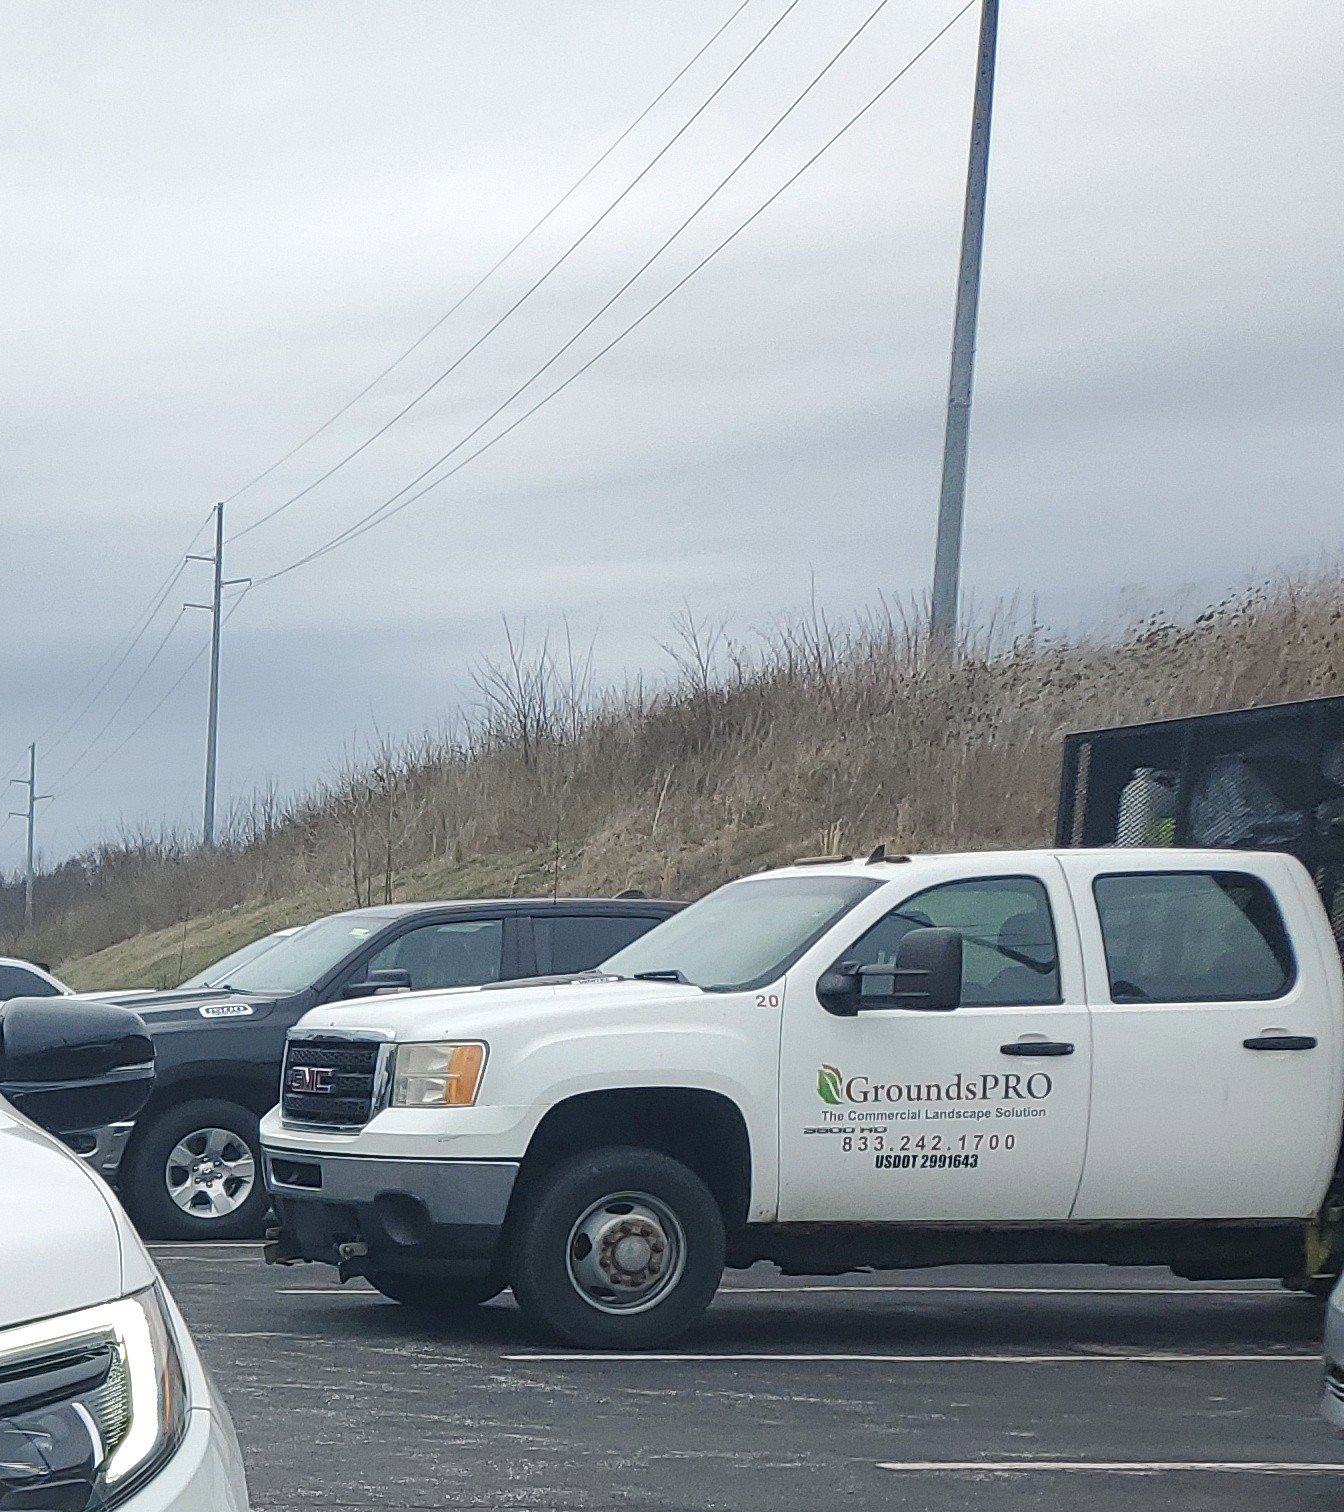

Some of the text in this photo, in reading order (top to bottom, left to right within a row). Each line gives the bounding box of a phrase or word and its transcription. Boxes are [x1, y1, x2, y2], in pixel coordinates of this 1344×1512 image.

[755, 994, 779, 1008] 20
[288, 1066, 333, 1093] GMC
[845, 1073, 1053, 1104] GroundsPRO
[822, 1107, 1046, 1122] The Commercial Landscape Solution
[842, 1134, 1016, 1152] 833.242.1700
[875, 1153, 979, 1169] USDOT 2991643
